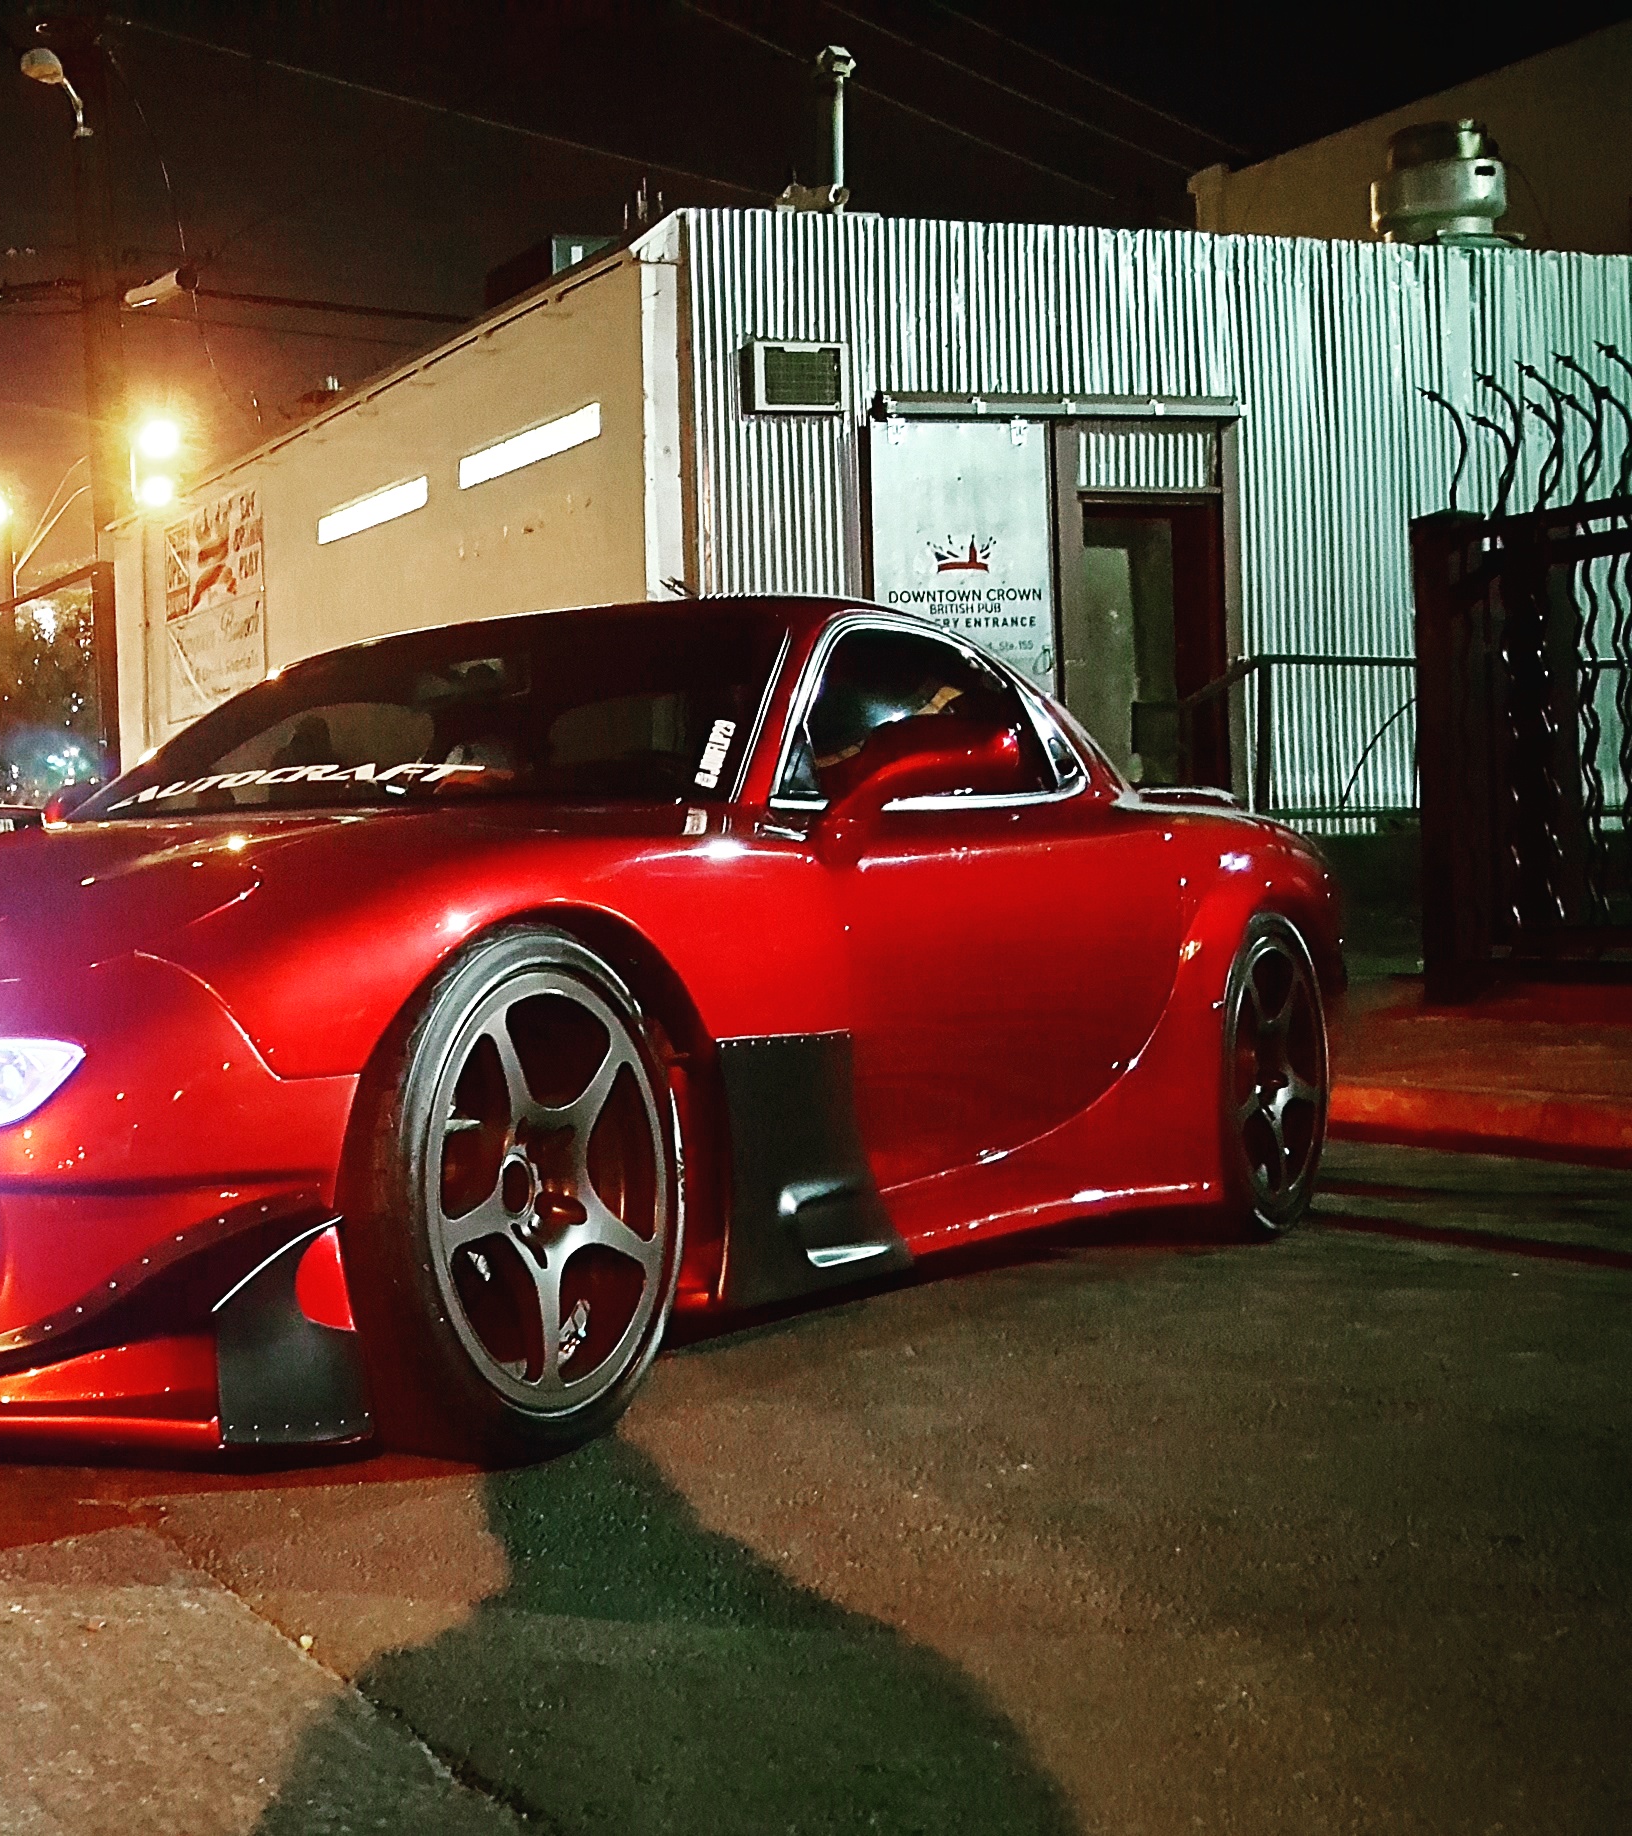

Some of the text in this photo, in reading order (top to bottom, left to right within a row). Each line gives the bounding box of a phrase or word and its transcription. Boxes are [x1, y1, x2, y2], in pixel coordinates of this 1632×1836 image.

[888, 588, 1042, 604] DOWNTOWN CROWN
[929, 602, 1002, 615] BRITISH PUB
[965, 616, 1037, 628] ENTRANCE
[106, 763, 486, 813] AUTOCRAFT
